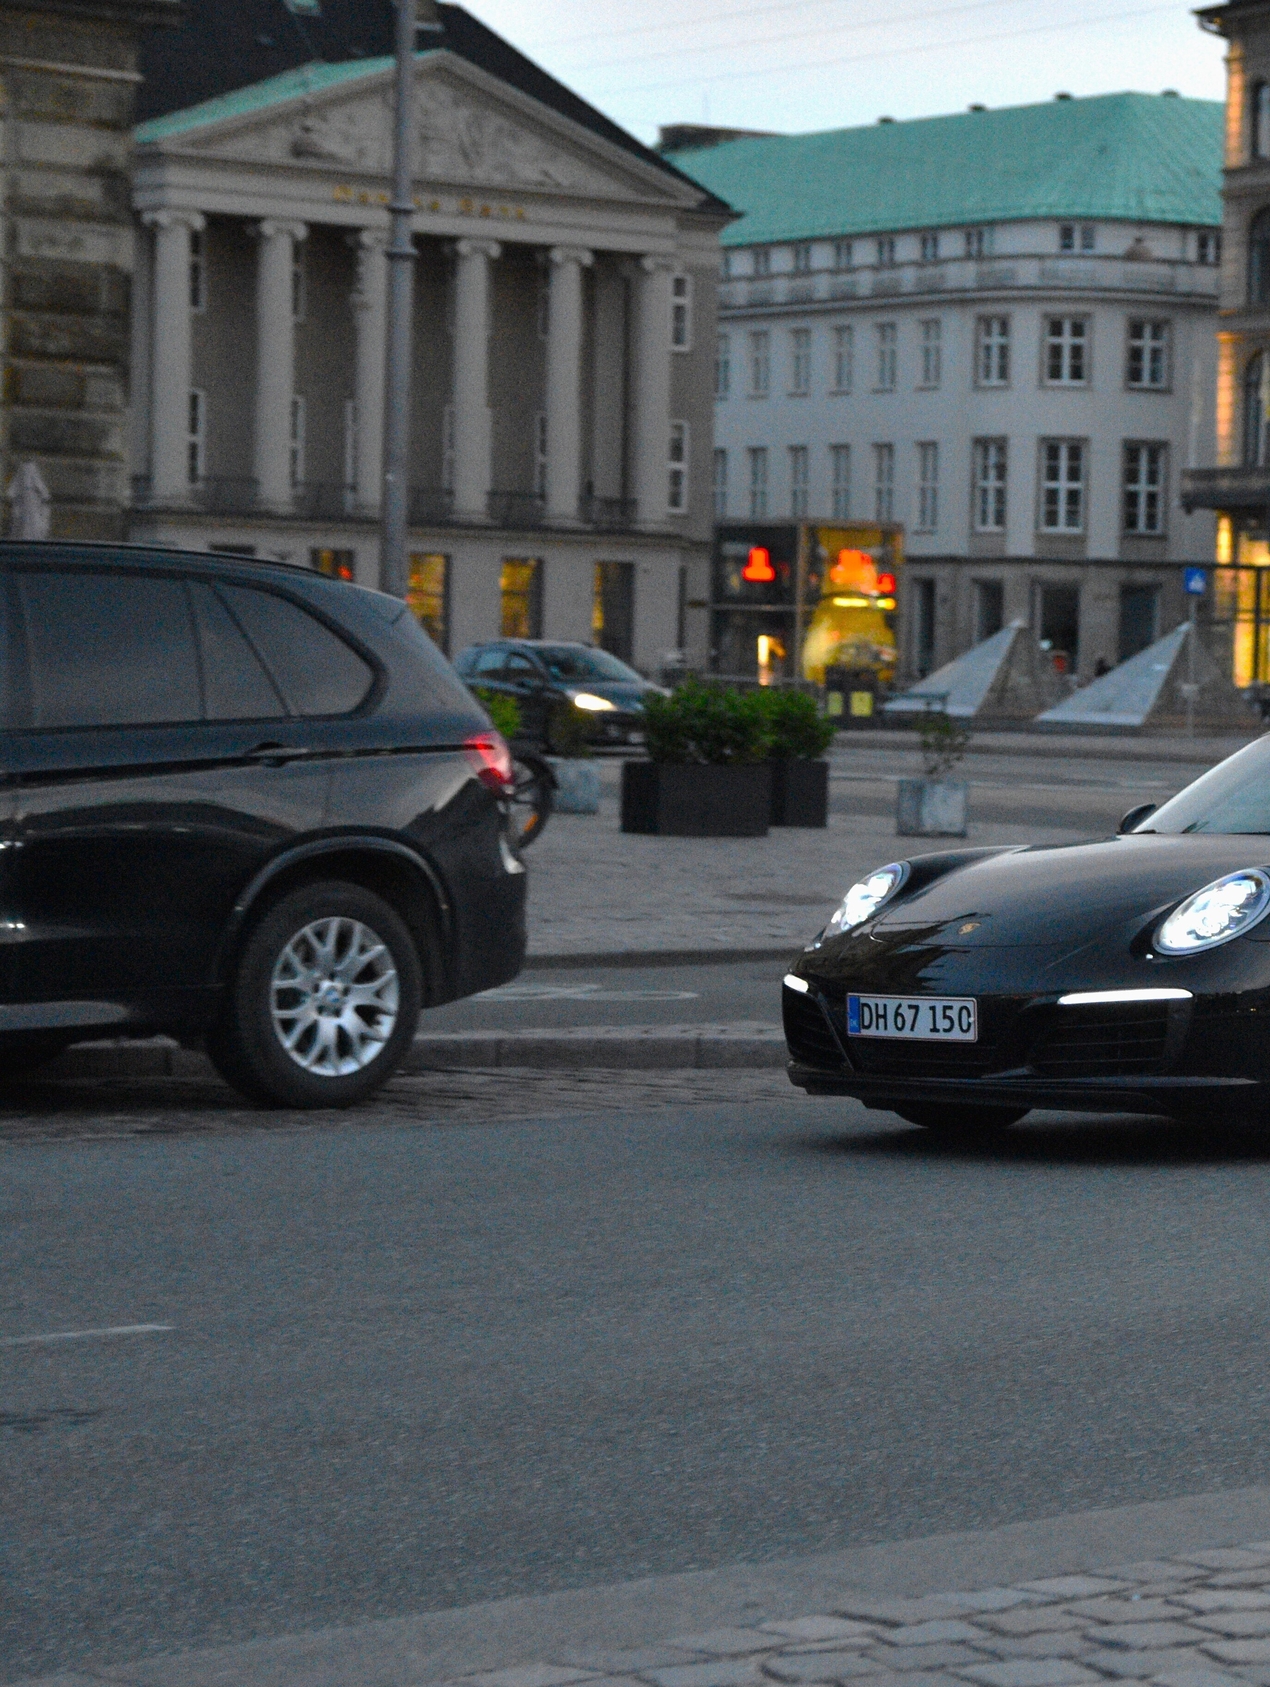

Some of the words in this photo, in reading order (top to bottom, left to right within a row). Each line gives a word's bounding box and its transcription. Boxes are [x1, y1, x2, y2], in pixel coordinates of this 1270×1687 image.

[861, 1002, 888, 1031] DH
[893, 1003, 920, 1032] 67
[929, 1005, 972, 1034] 150
